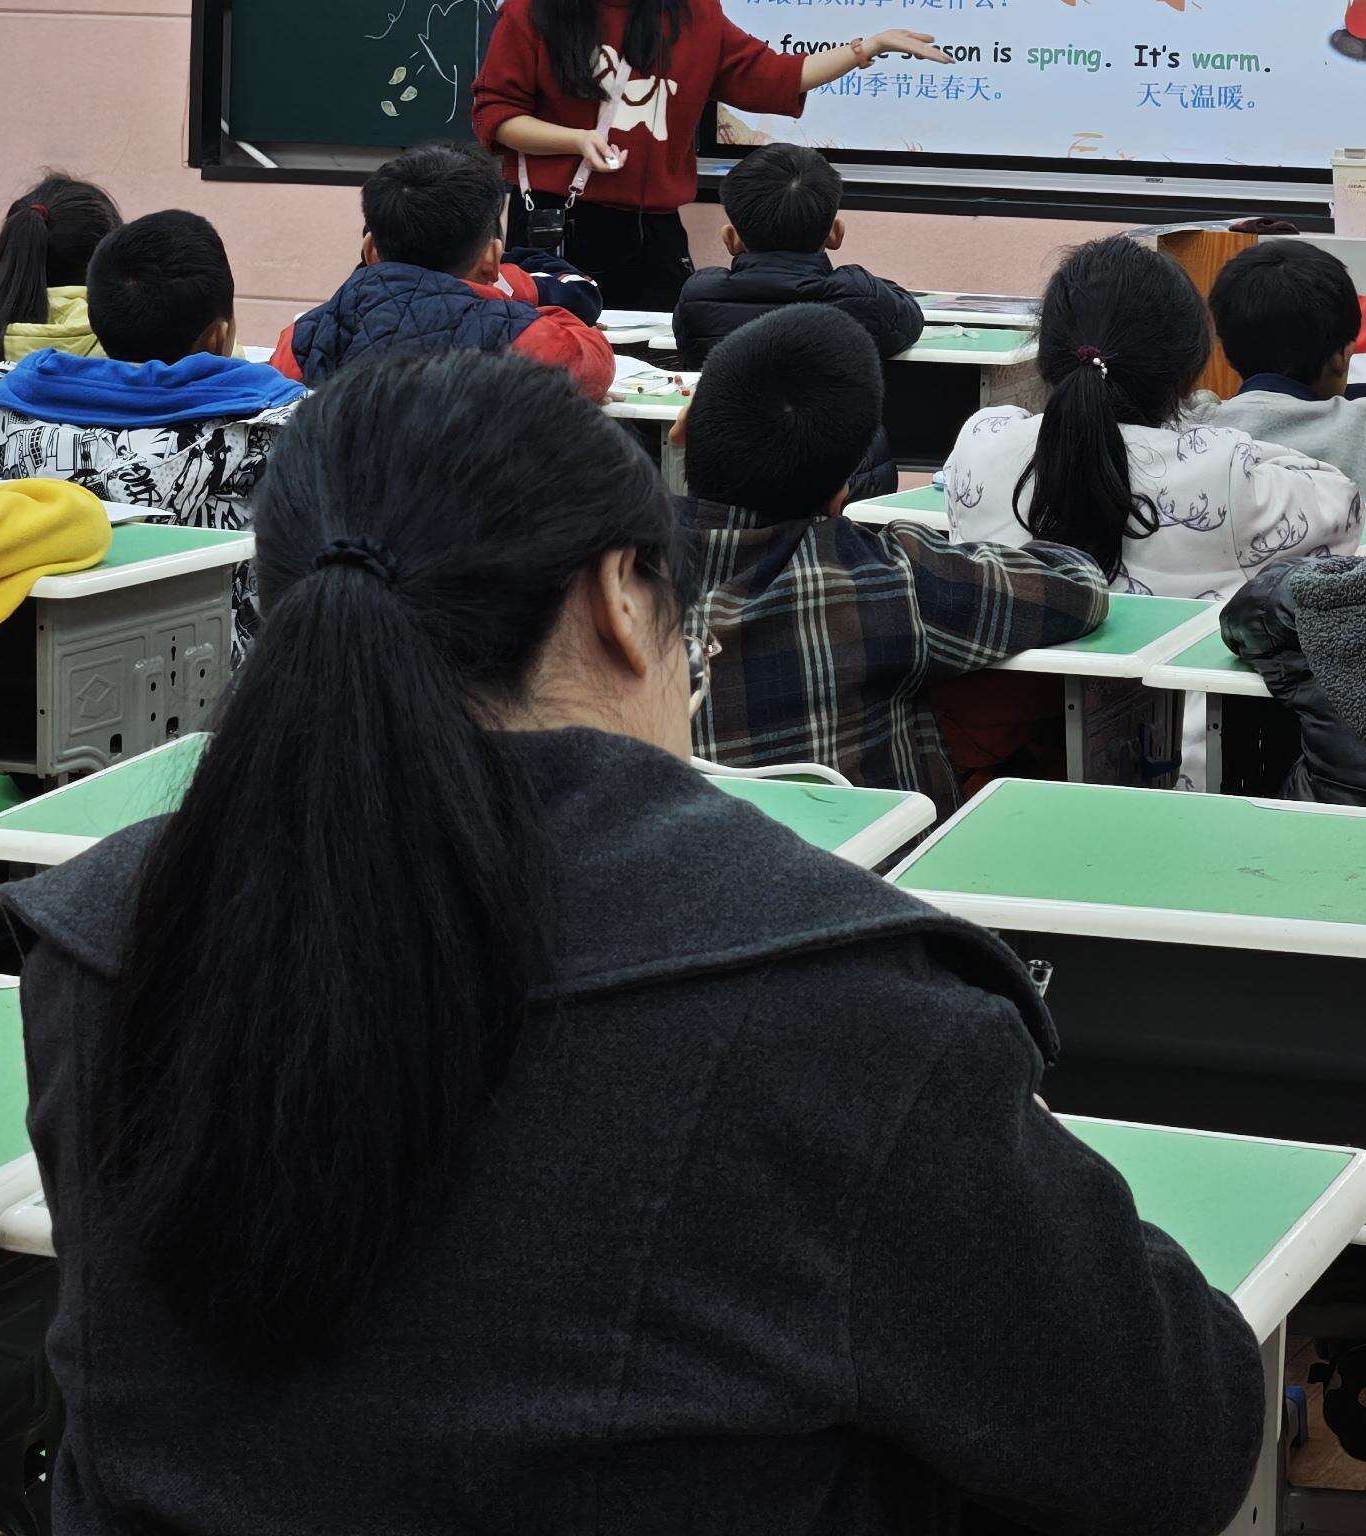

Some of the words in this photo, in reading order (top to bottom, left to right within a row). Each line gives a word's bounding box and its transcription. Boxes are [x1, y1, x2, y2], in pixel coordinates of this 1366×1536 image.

[993, 41, 1012, 63] is
[1134, 44, 1181, 69] It's
[1137, 81, 1256, 112] 天气温暖。
